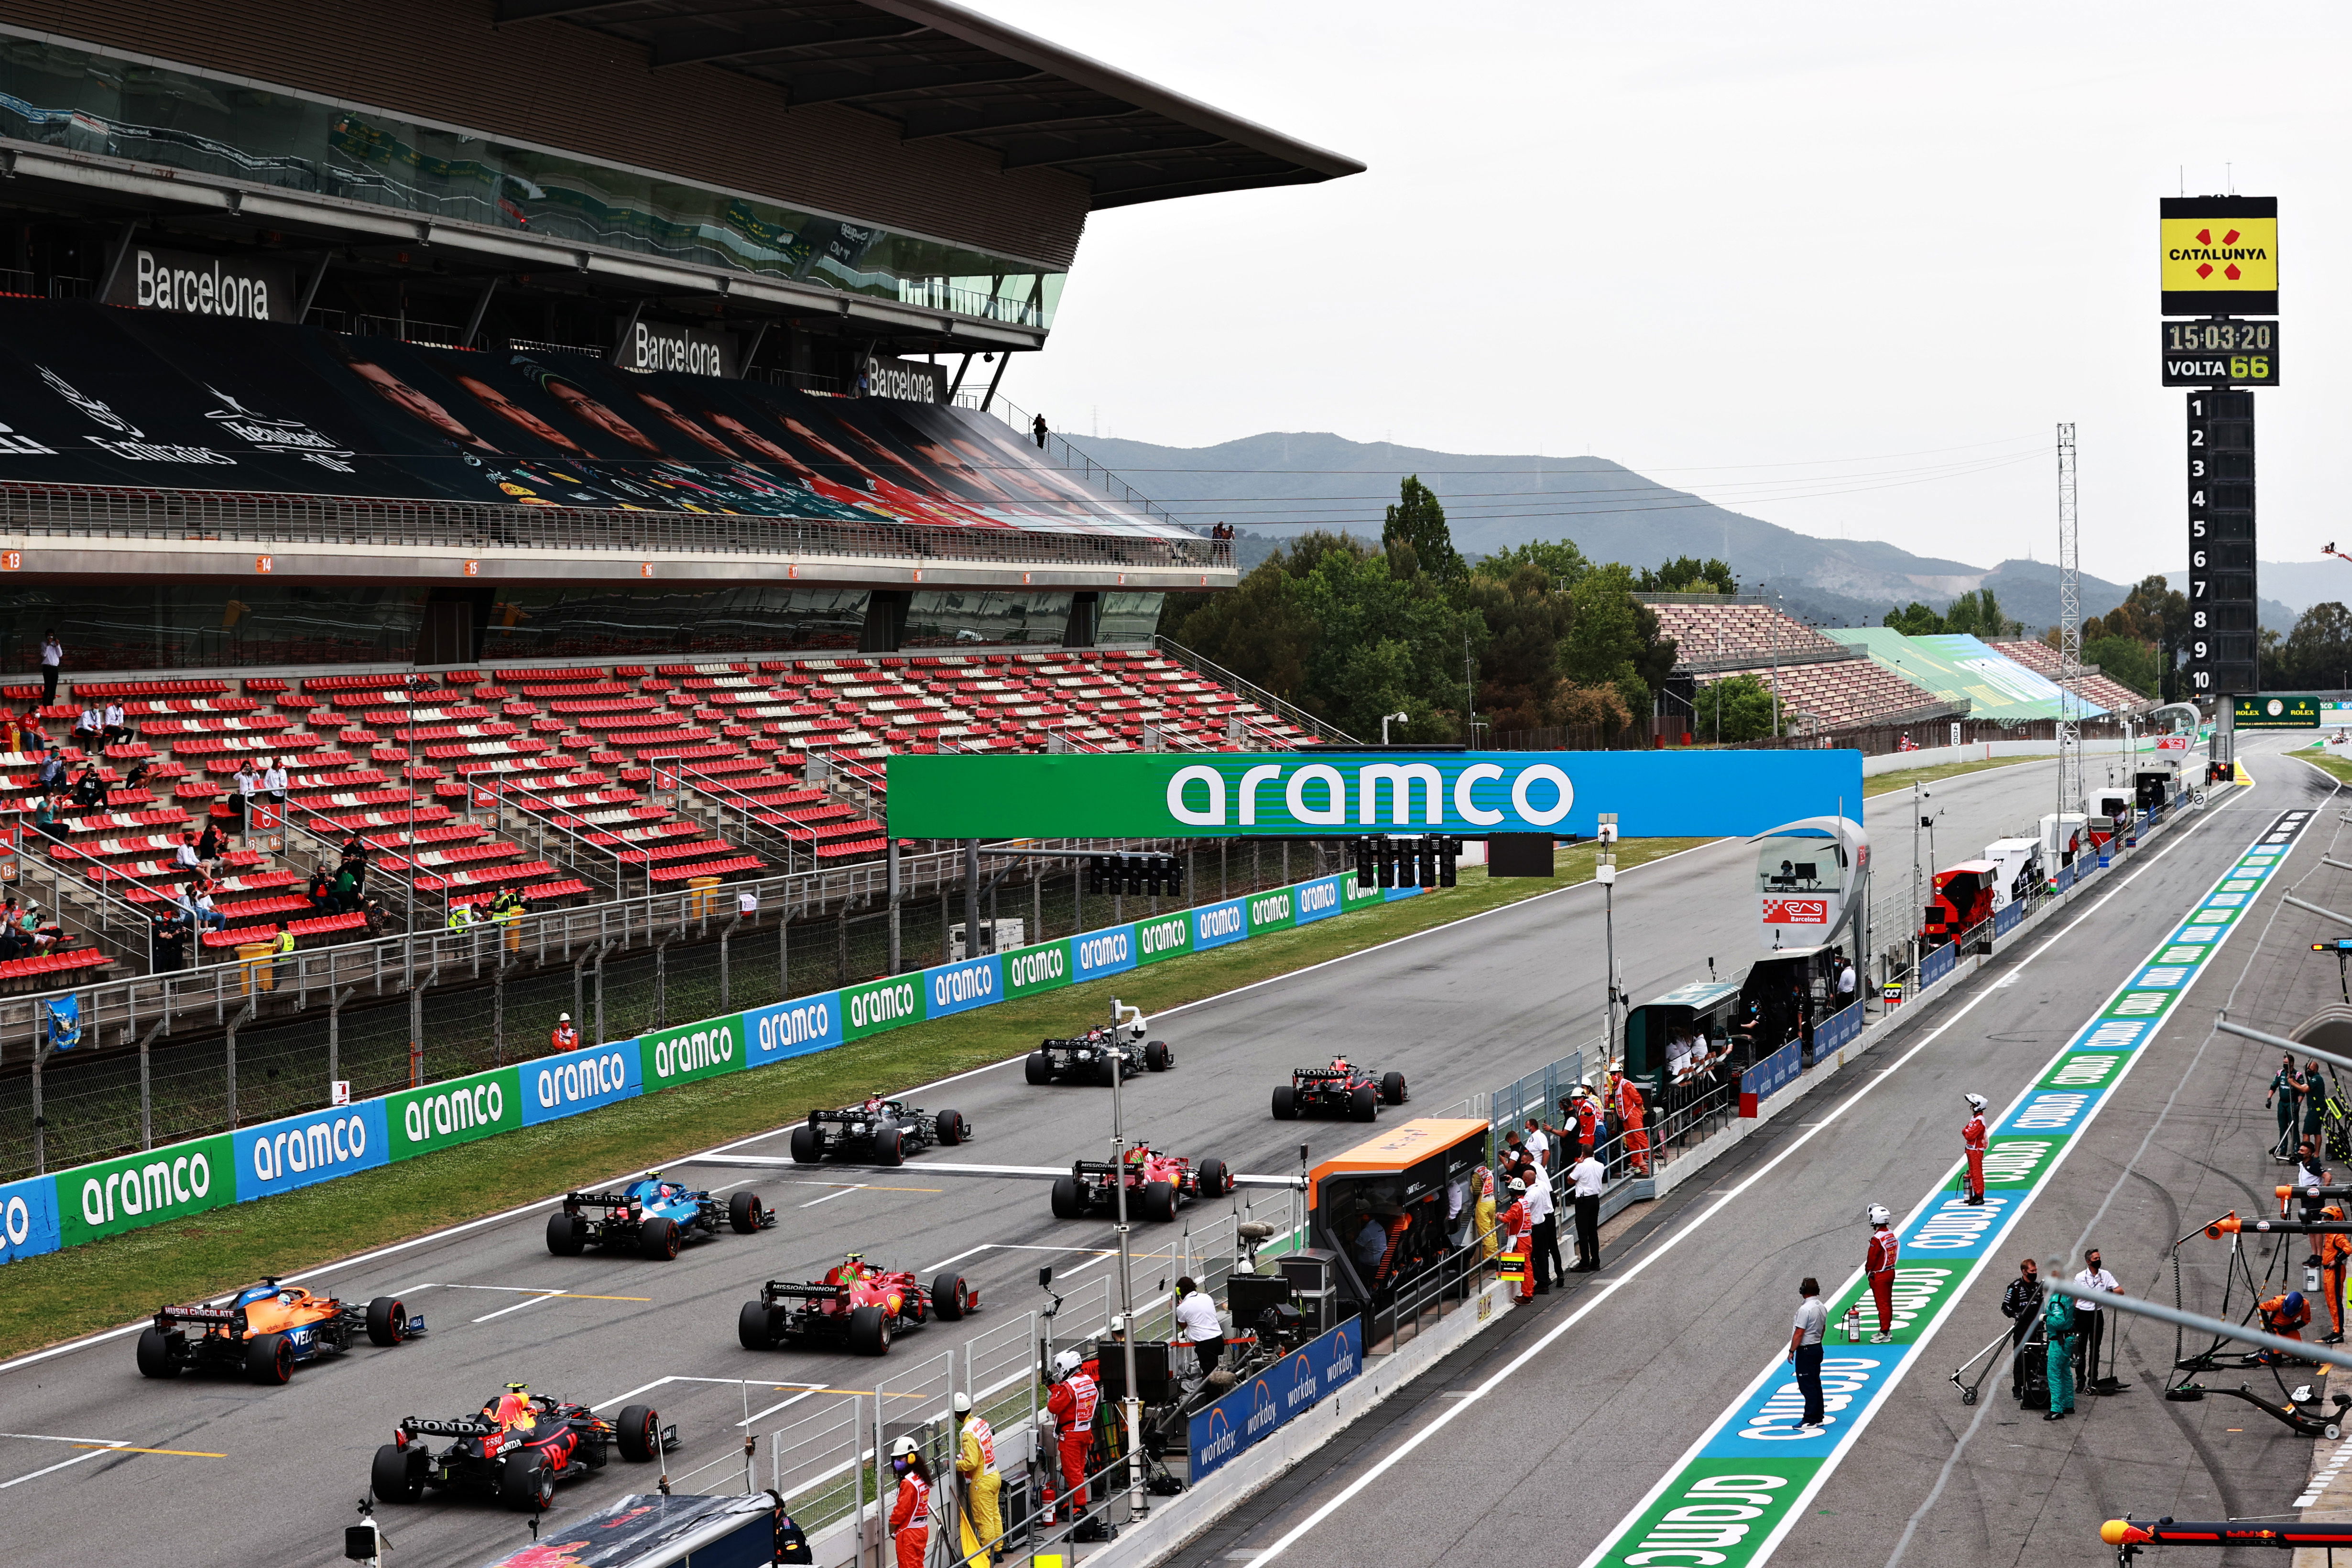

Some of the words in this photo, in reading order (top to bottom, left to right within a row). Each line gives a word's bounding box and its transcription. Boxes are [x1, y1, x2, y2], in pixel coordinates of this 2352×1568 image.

[2169, 249, 2266, 260] CATALUNYA
[138, 250, 269, 320] Barcelona
[2169, 326, 2270, 349] 15:03:20
[636, 323, 721, 378] Barcelona
[2168, 361, 2226, 376] VOLTA
[2231, 356, 2269, 378] 66
[870, 357, 934, 403] Barcelona
[2192, 400, 2202, 416] 1
[2192, 430, 2204, 446] 2
[82, 436, 237, 465] Emirates
[2192, 461, 2205, 477] 3
[2192, 491, 2205, 507] 4
[2194, 521, 2205, 537] 5
[9, 553, 20, 568] 13
[262, 557, 272, 571] 14
[469, 562, 478, 575] 15
[646, 564, 652, 576] 16
[2194, 551, 2206, 567] 6
[792, 566, 798, 577] 17
[917, 571, 922, 581] 18
[2194, 581, 2206, 597] 7
[2194, 611, 2207, 628] 8
[2194, 642, 2207, 658] 9
[2193, 671, 2210, 687] 10
[1166, 763, 1574, 827] aramco
[271, 837, 277, 847] 14
[1301, 882, 1335, 913] aramco
[1253, 894, 1289, 926] aramco
[1200, 906, 1240, 939] aramco
[1143, 919, 1186, 954] aramco
[1080, 933, 1127, 969] aramco
[1012, 948, 1063, 987] aramco
[936, 964, 992, 1006] aramco
[851, 982, 914, 1028] aramco
[2112, 992, 2170, 1015] aramco
[759, 1003, 828, 1051] aramco
[2084, 1021, 2146, 1047] aramco
[654, 1025, 732, 1076] aramco
[537, 1051, 627, 1108] aramco
[2050, 1055, 2120, 1085] aramco
[403, 1081, 503, 1141] aramco
[2012, 1093, 2089, 1129] aramco
[254, 1115, 366, 1181] aramco
[1982, 1141, 2052, 1183] aramco
[82, 1152, 210, 1226] aramco
[1906, 1197, 2008, 1250] aramco
[165, 1307, 189, 1317] HUSKI
[190, 1309, 235, 1318] CHOCOLATE
[410, 1318, 422, 1328] VELO
[407, 1420, 488, 1434] HONDA
[486, 1435, 502, 1445] ESSO
